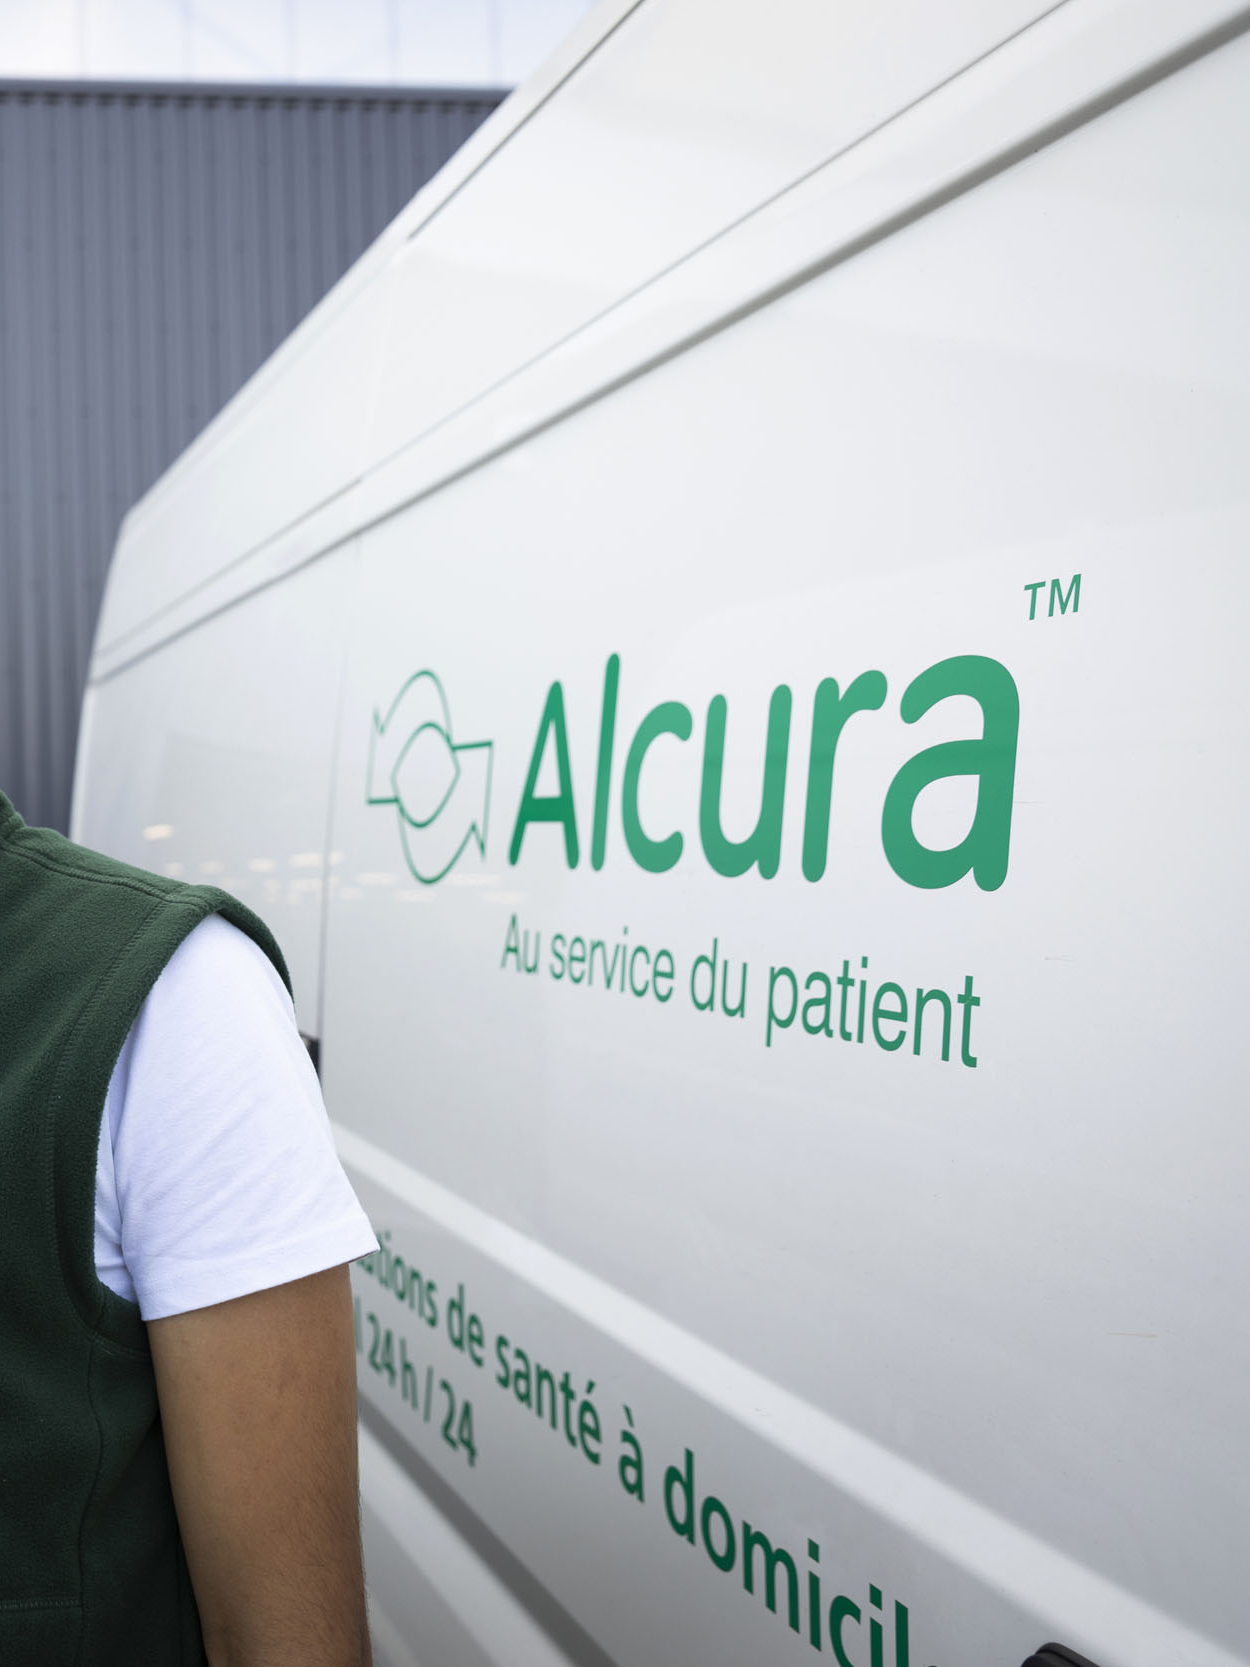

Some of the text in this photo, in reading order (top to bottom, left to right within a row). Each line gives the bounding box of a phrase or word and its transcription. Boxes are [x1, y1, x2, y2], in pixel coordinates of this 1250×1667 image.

[1023, 573, 1082, 622] TM
[508, 652, 1020, 892] Alcura
[500, 913, 981, 1068] Au service du patient
[446, 1282, 484, 1369] de
[495, 1332, 602, 1465] santé
[618, 1404, 645, 1503] à
[663, 1447, 940, 1667] domicil
